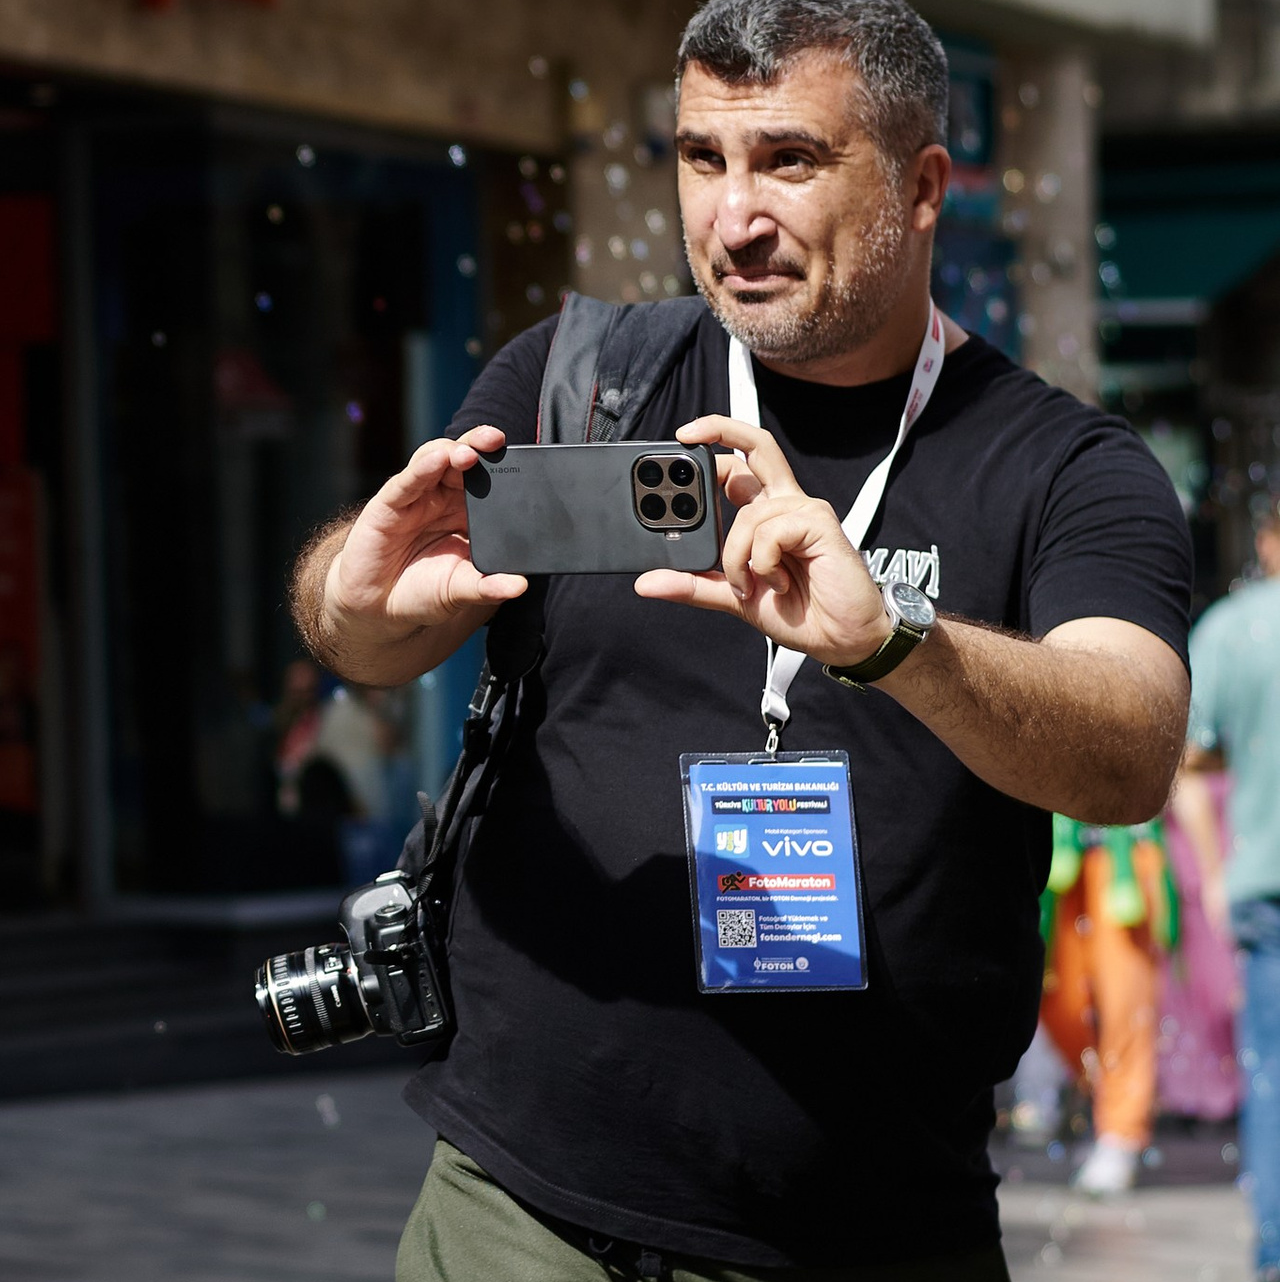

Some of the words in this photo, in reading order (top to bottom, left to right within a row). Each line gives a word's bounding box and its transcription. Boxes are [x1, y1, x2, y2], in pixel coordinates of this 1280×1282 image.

[701, 783, 716, 792] T.C.
[716, 782, 749, 792] KÜLTÜR
[750, 783, 761, 792] VE
[762, 781, 794, 792] TURİZM
[794, 781, 840, 792] BAKANLIĞI
[773, 798, 797, 811] YOLU
[761, 835, 834, 857] vivo
[748, 876, 831, 888] FotoMaraton
[761, 962, 794, 970] FOTON
